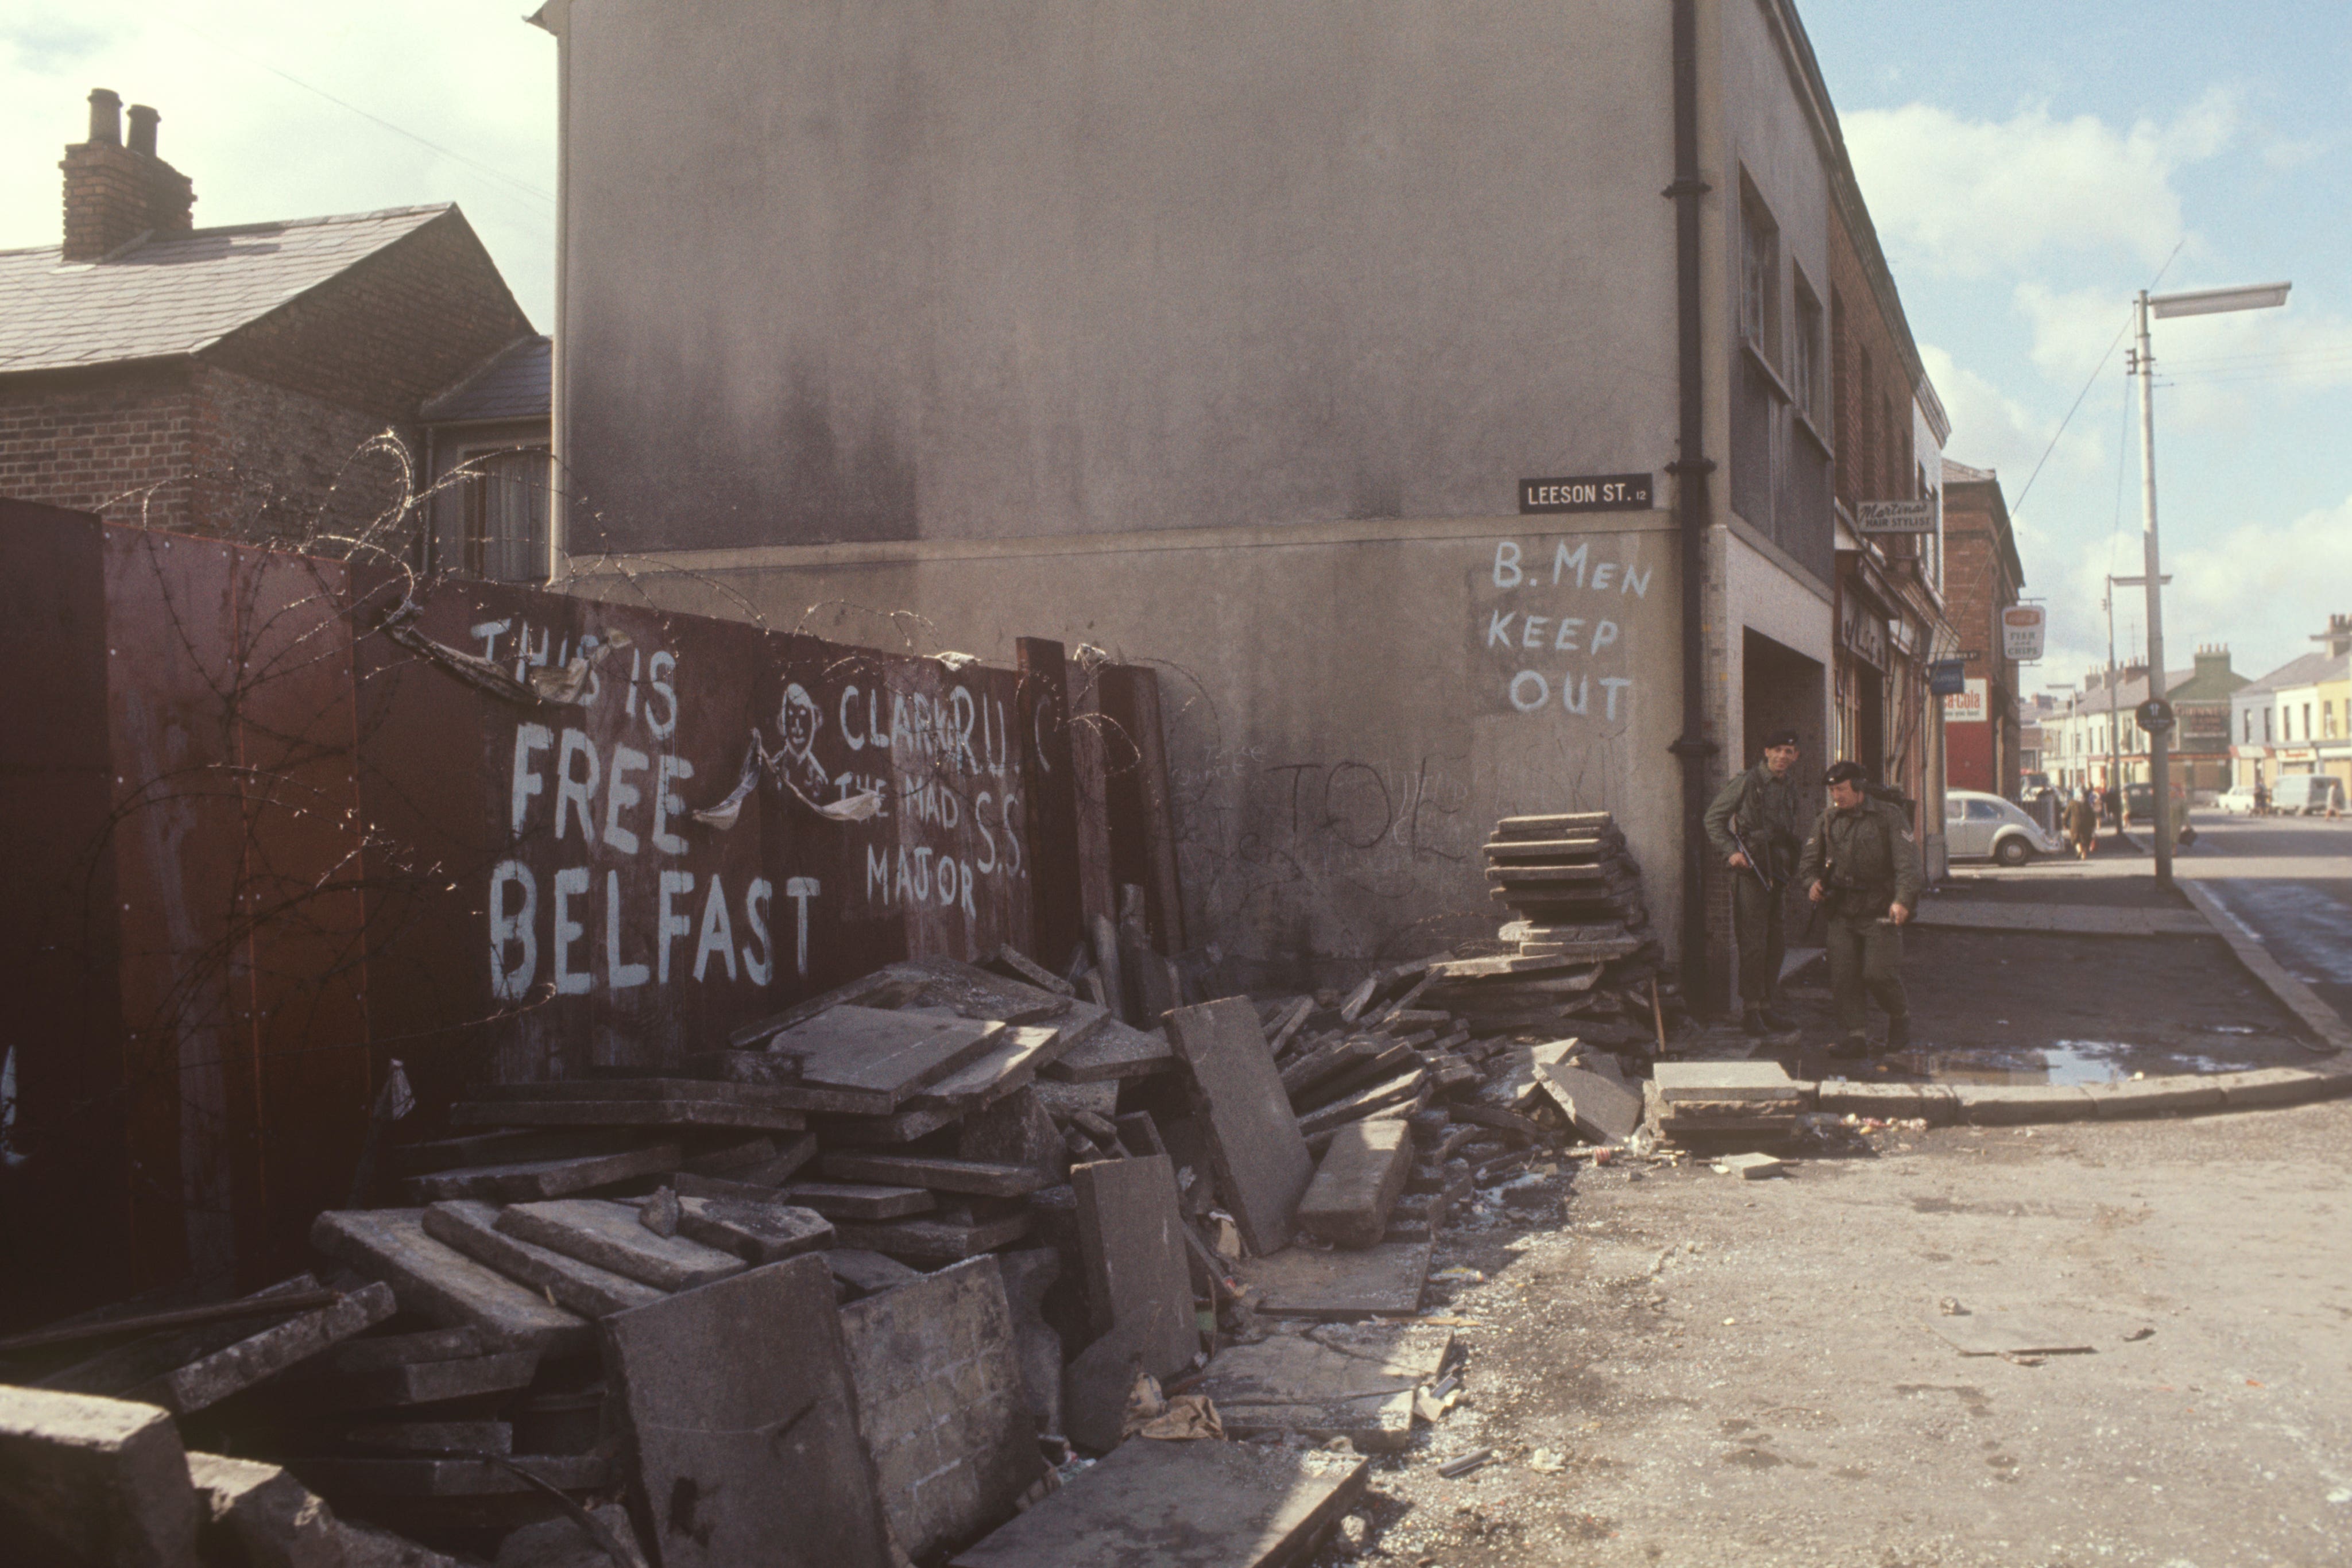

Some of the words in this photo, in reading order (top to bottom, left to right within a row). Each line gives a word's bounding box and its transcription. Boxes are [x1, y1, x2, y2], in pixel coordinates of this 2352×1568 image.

[1528, 485, 1596, 505] LEESON
[1603, 483, 1632, 502] ST.
[1637, 490, 1647, 500] 12
[1866, 518, 1889, 526] HAIR
[1891, 517, 1930, 526] STYLIST
[1488, 609, 1619, 656] KEEP
[625, 647, 677, 741] IS
[1509, 669, 1633, 722] OUT
[1944, 689, 1980, 708] a-Cola
[512, 723, 694, 855] FREE
[904, 775, 958, 831] MAD
[867, 843, 976, 919] MAJOR
[489, 860, 821, 1000] BELFAST
